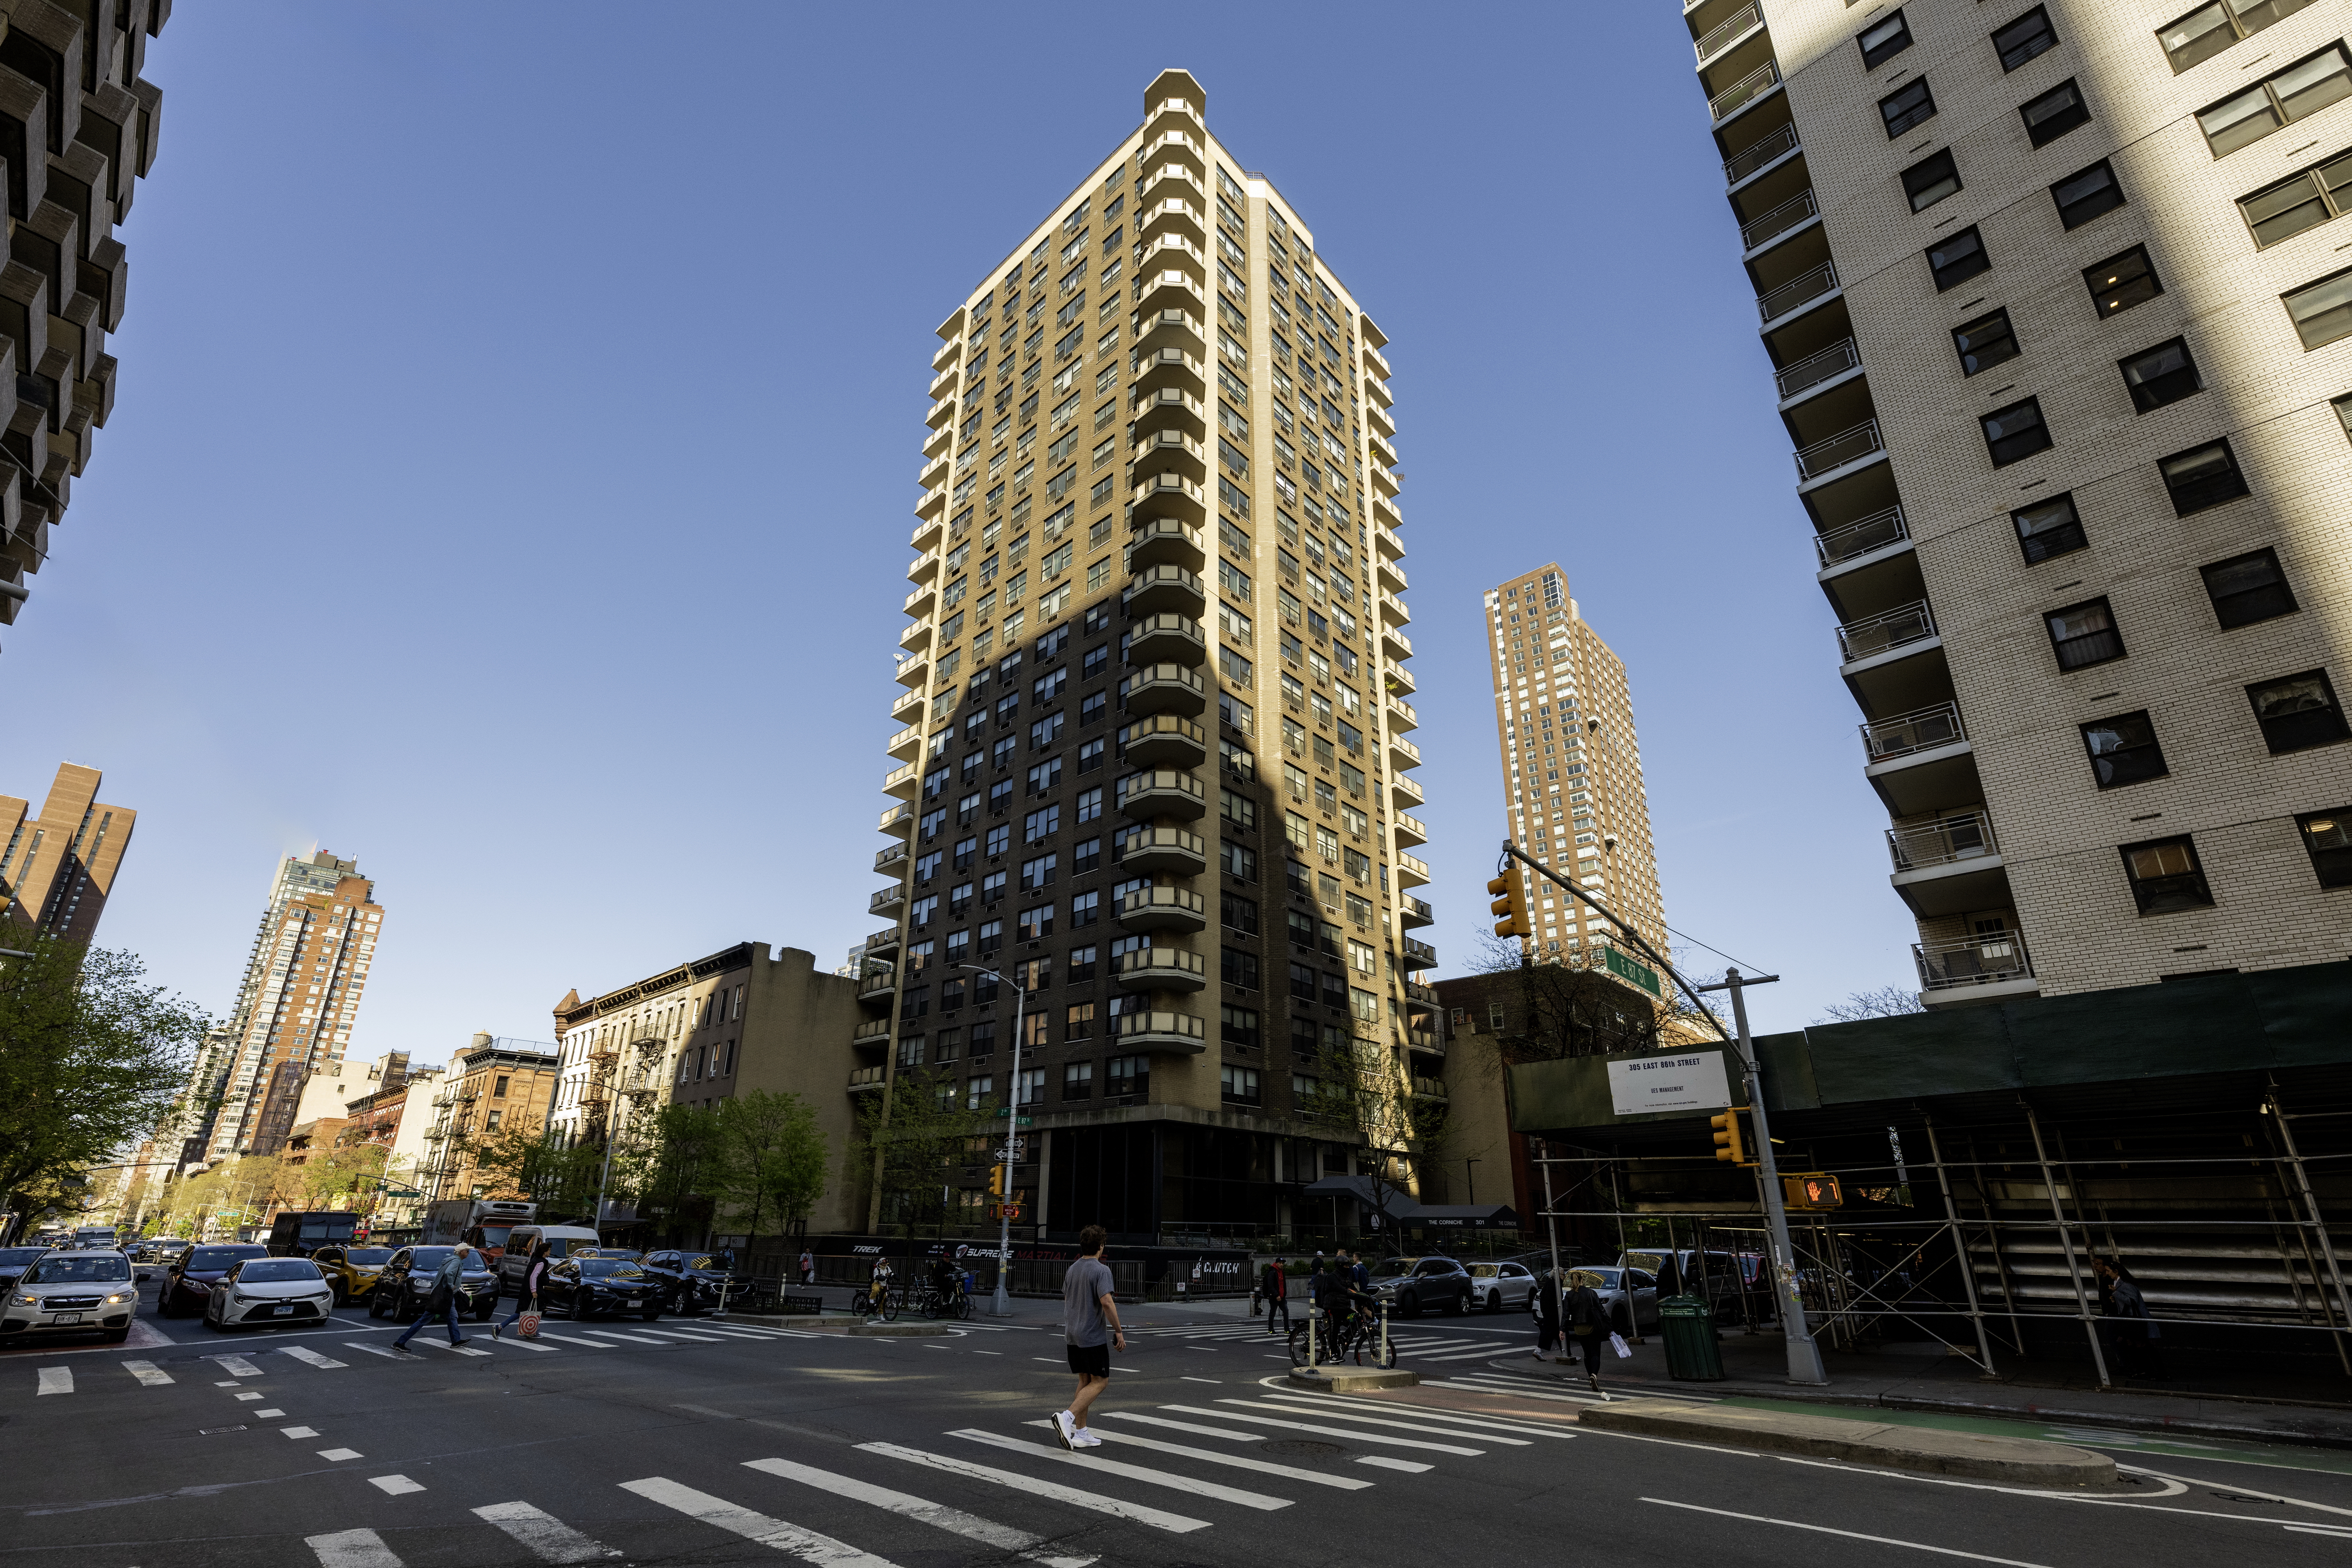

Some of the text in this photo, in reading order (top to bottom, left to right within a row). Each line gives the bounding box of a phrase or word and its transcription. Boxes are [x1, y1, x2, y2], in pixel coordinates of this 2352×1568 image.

[1620, 958, 1646, 985] E 87 St
[1677, 1058, 1700, 1067] STREET
[966, 1249, 1015, 1259] SUPREE
